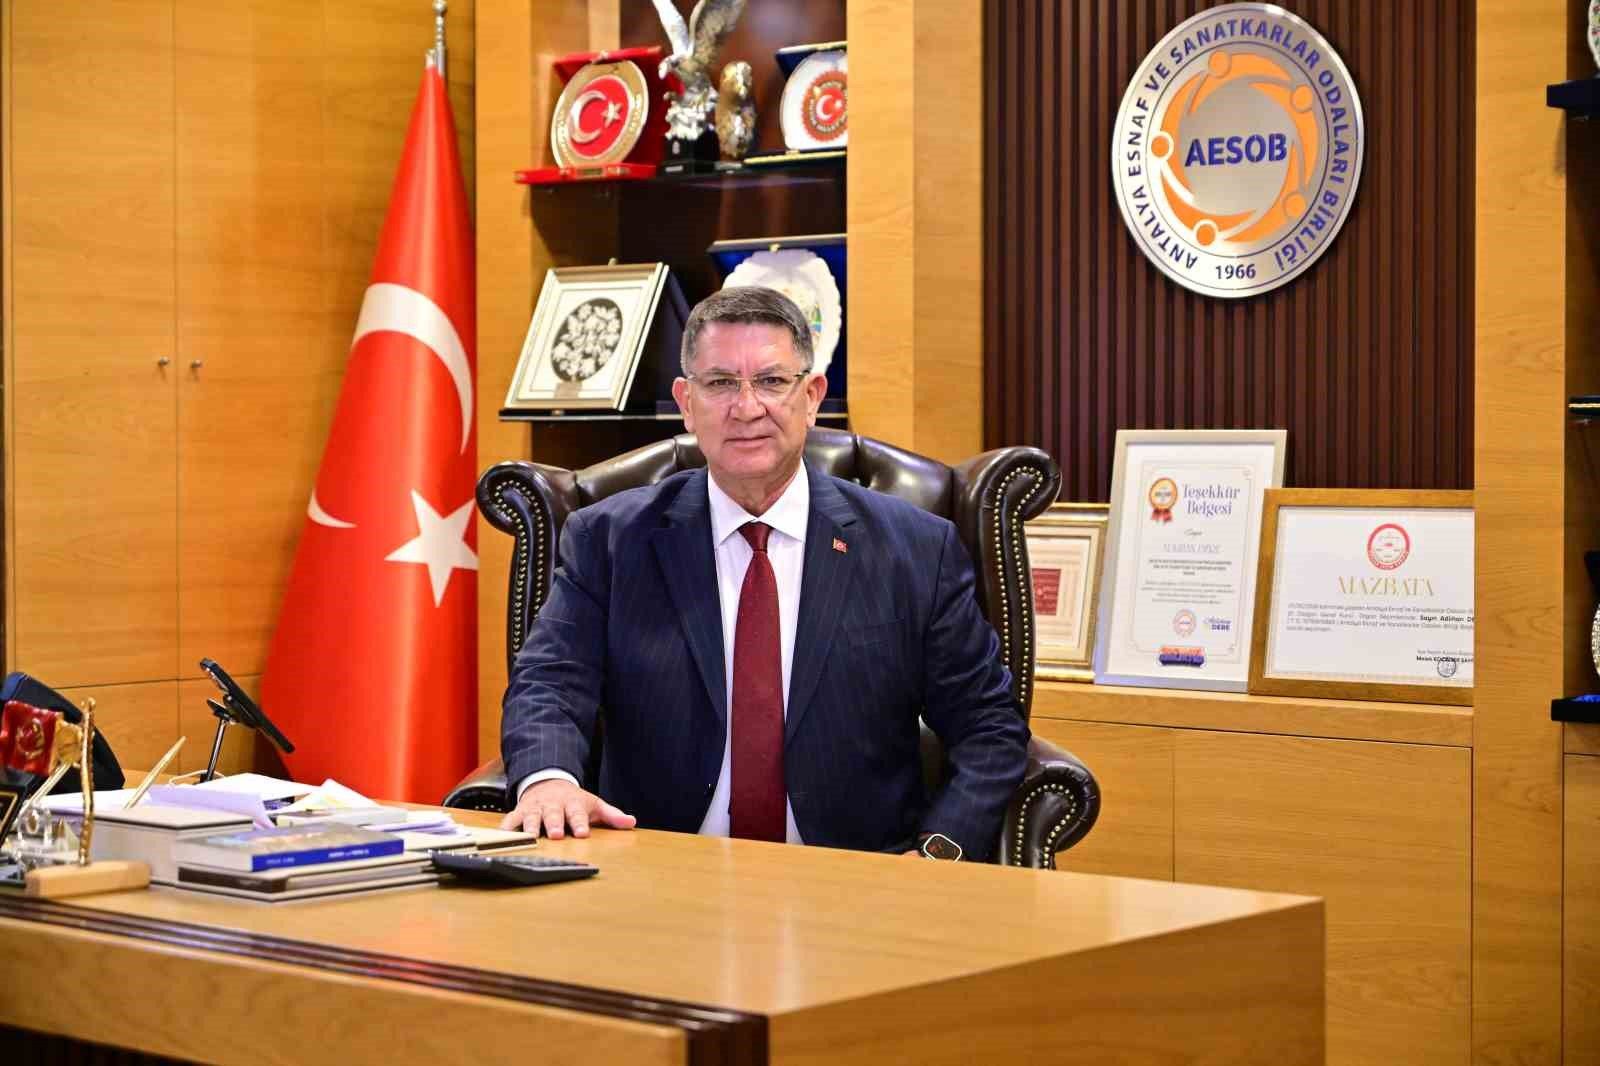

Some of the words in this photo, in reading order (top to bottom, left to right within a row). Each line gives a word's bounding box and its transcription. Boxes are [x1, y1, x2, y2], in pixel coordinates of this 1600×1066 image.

[1170, 18, 1321, 69] SANATKARLAR
[1144, 62, 1170, 92] VE
[1128, 97, 1150, 177] ESNAF
[1318, 69, 1350, 184] ODALARI
[1184, 132, 1288, 168] AESOB
[1131, 184, 1198, 270] ANTALYA
[1274, 191, 1339, 271] BİRLİĞİ
[1215, 264, 1256, 280] 1966
[1182, 484, 1241, 501] Teşekkür
[1187, 500, 1232, 517] Belgesi
[1337, 576, 1435, 596] MAZBATA
